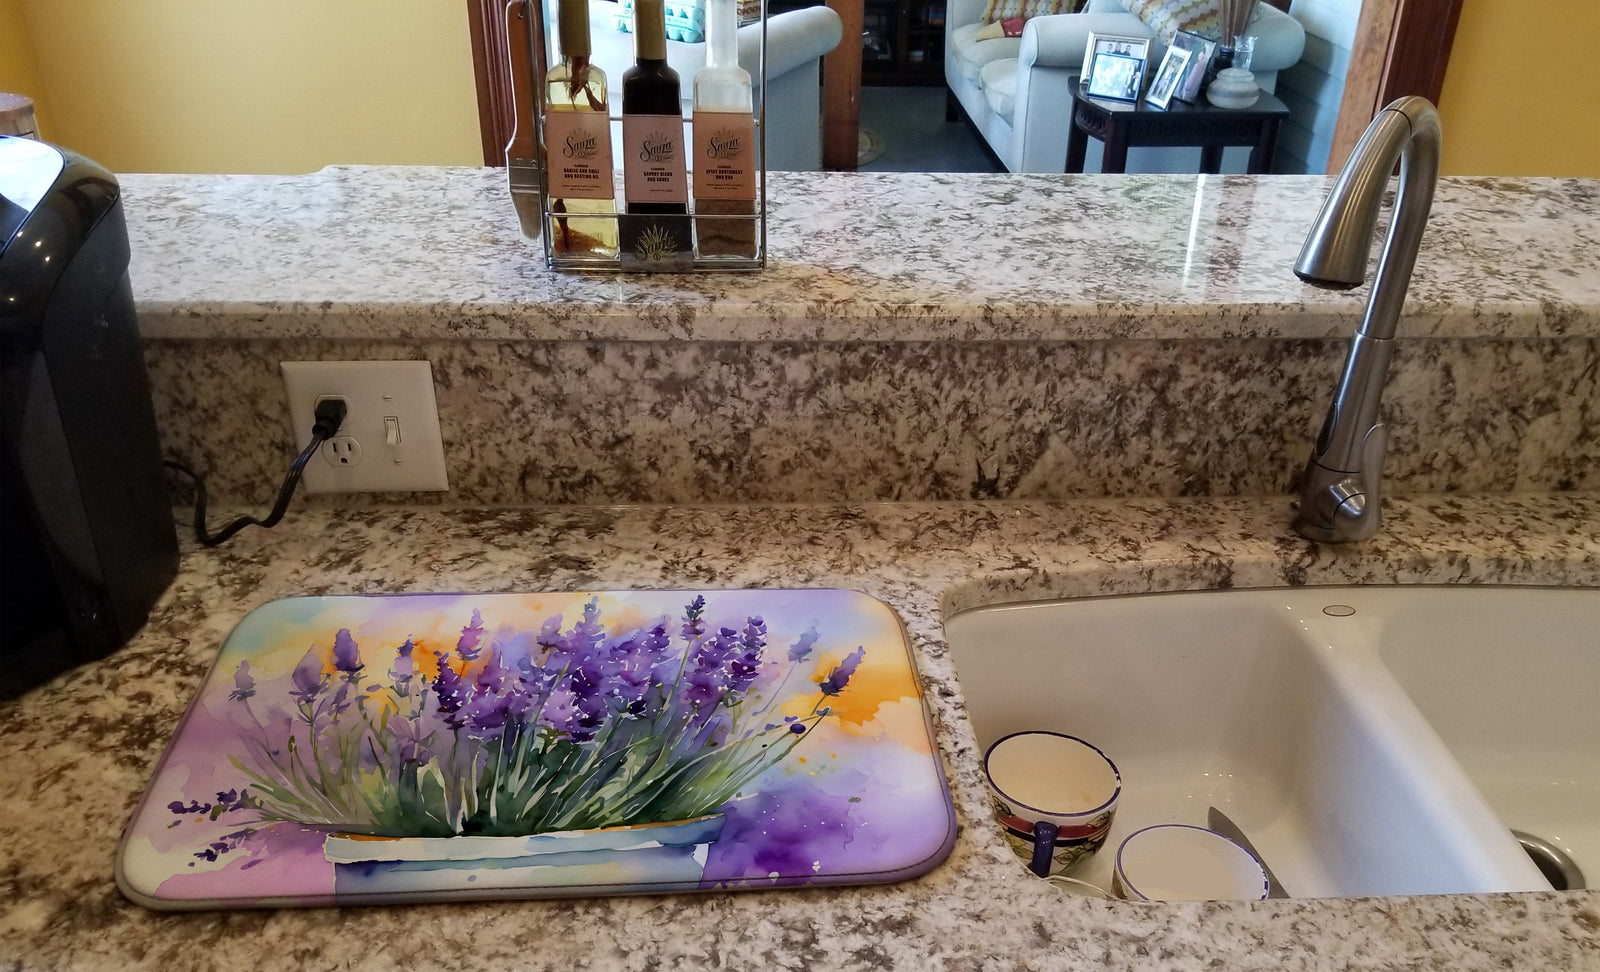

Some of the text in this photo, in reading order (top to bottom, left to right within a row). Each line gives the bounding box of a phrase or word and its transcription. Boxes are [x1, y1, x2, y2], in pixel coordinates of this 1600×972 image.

[563, 136, 597, 158] Sauza
[640, 140, 674, 161] Sauza
[707, 137, 740, 158] Sauza
